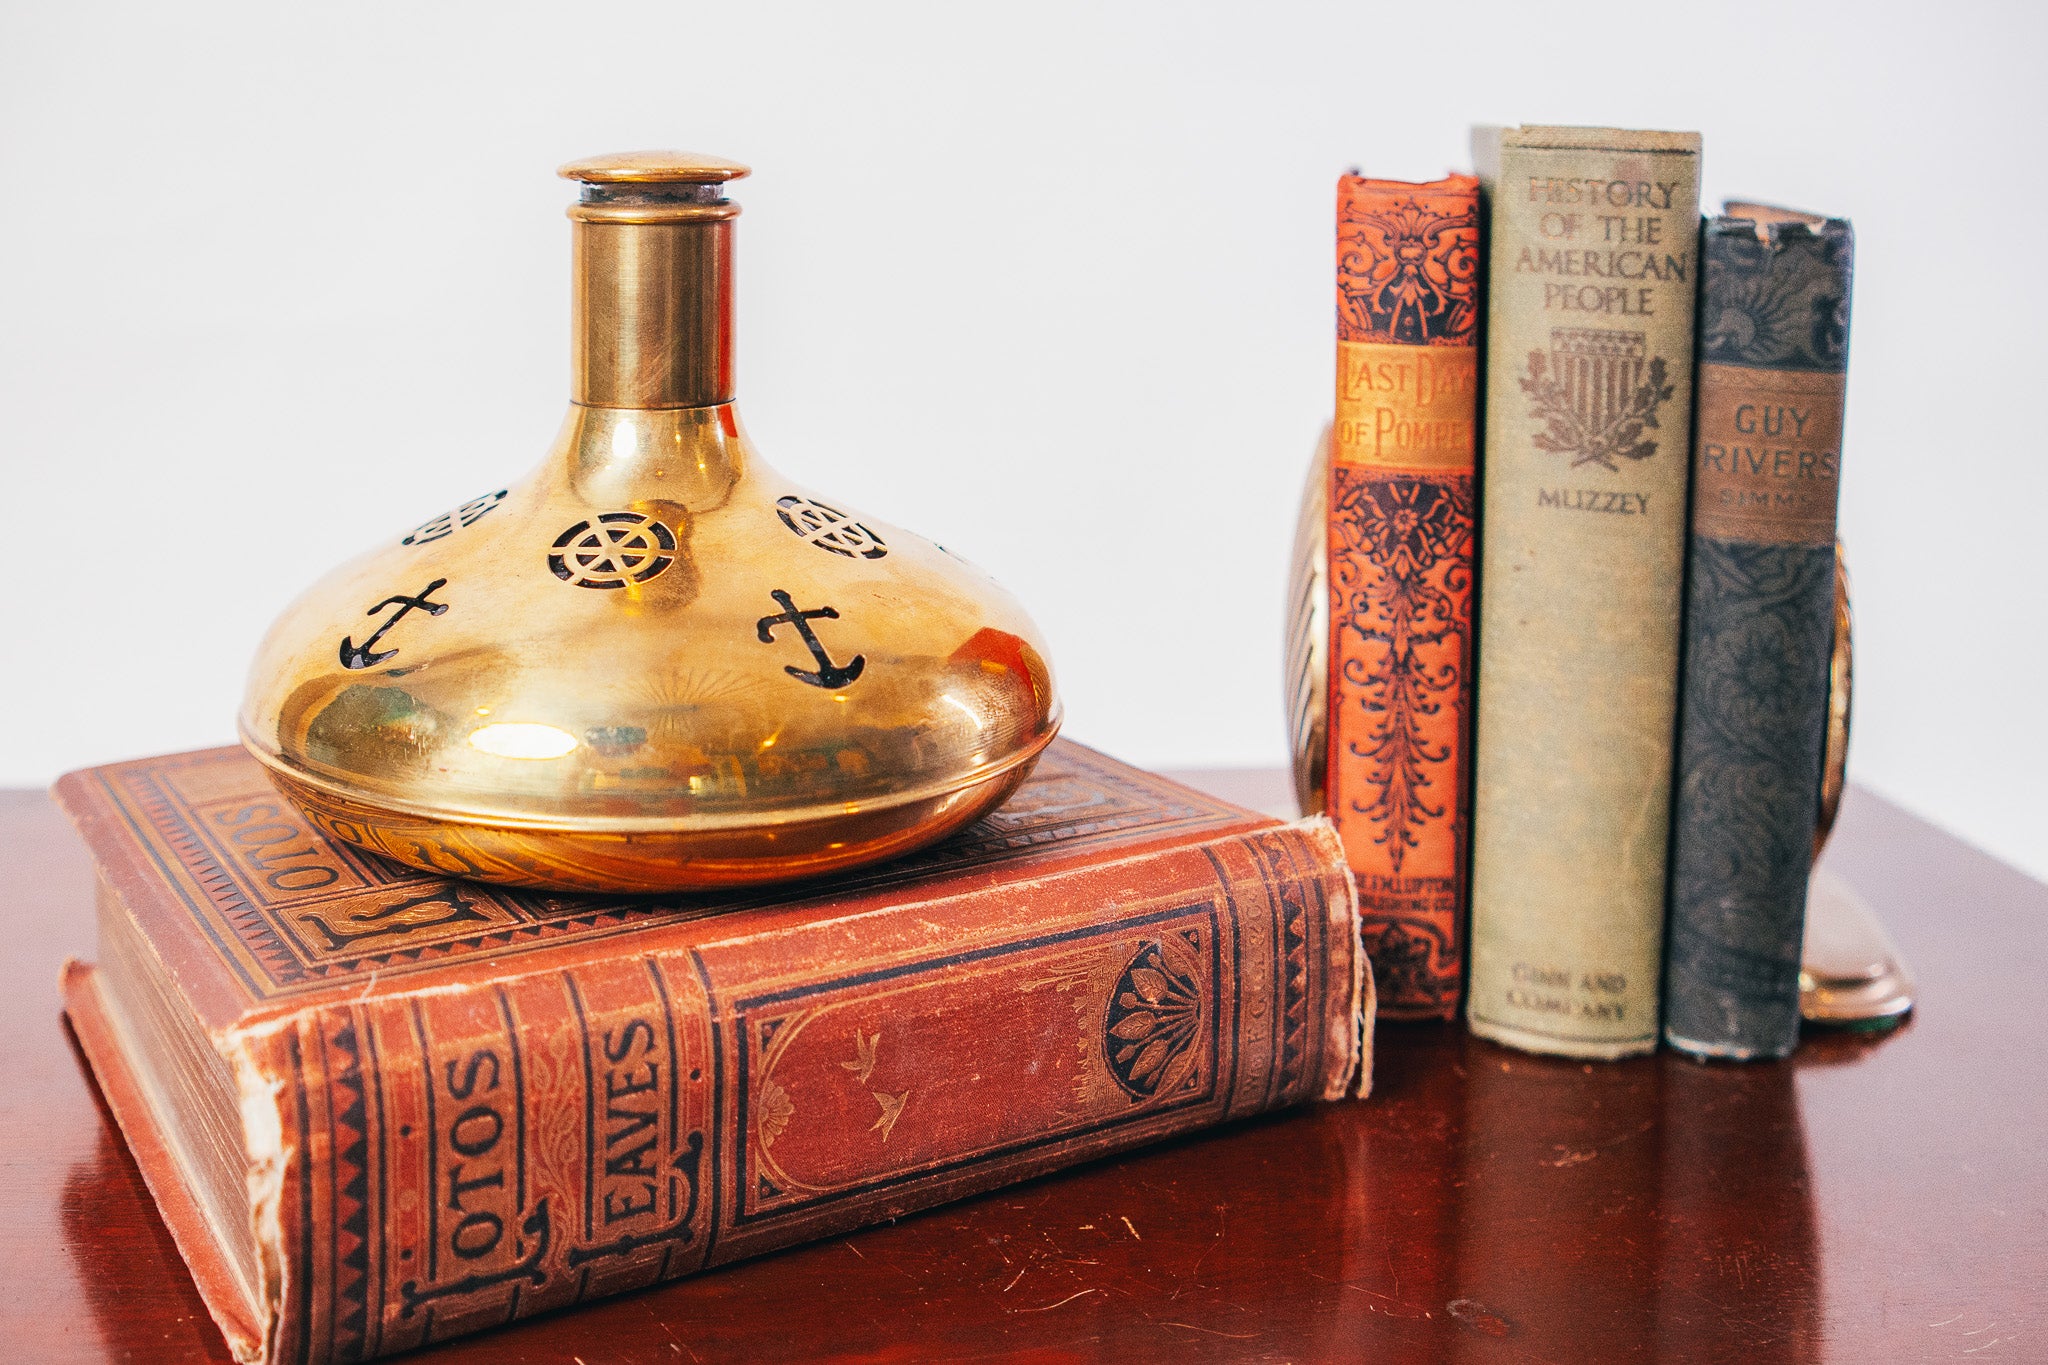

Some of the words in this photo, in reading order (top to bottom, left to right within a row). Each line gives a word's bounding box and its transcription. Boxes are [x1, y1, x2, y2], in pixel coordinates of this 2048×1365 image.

[1528, 175, 1681, 210] HISTORY
[1538, 212, 1585, 242] OF
[1597, 214, 1663, 246] THE
[1514, 245, 1689, 283] AMERICAN
[1542, 282, 1656, 316] PEOPLE
[1337, 345, 1412, 403] LAST
[1339, 419, 1371, 447] OF
[1735, 403, 1812, 439] GUY
[1702, 443, 1836, 481] RIVERS
[1538, 487, 1650, 516] MUZZEY
